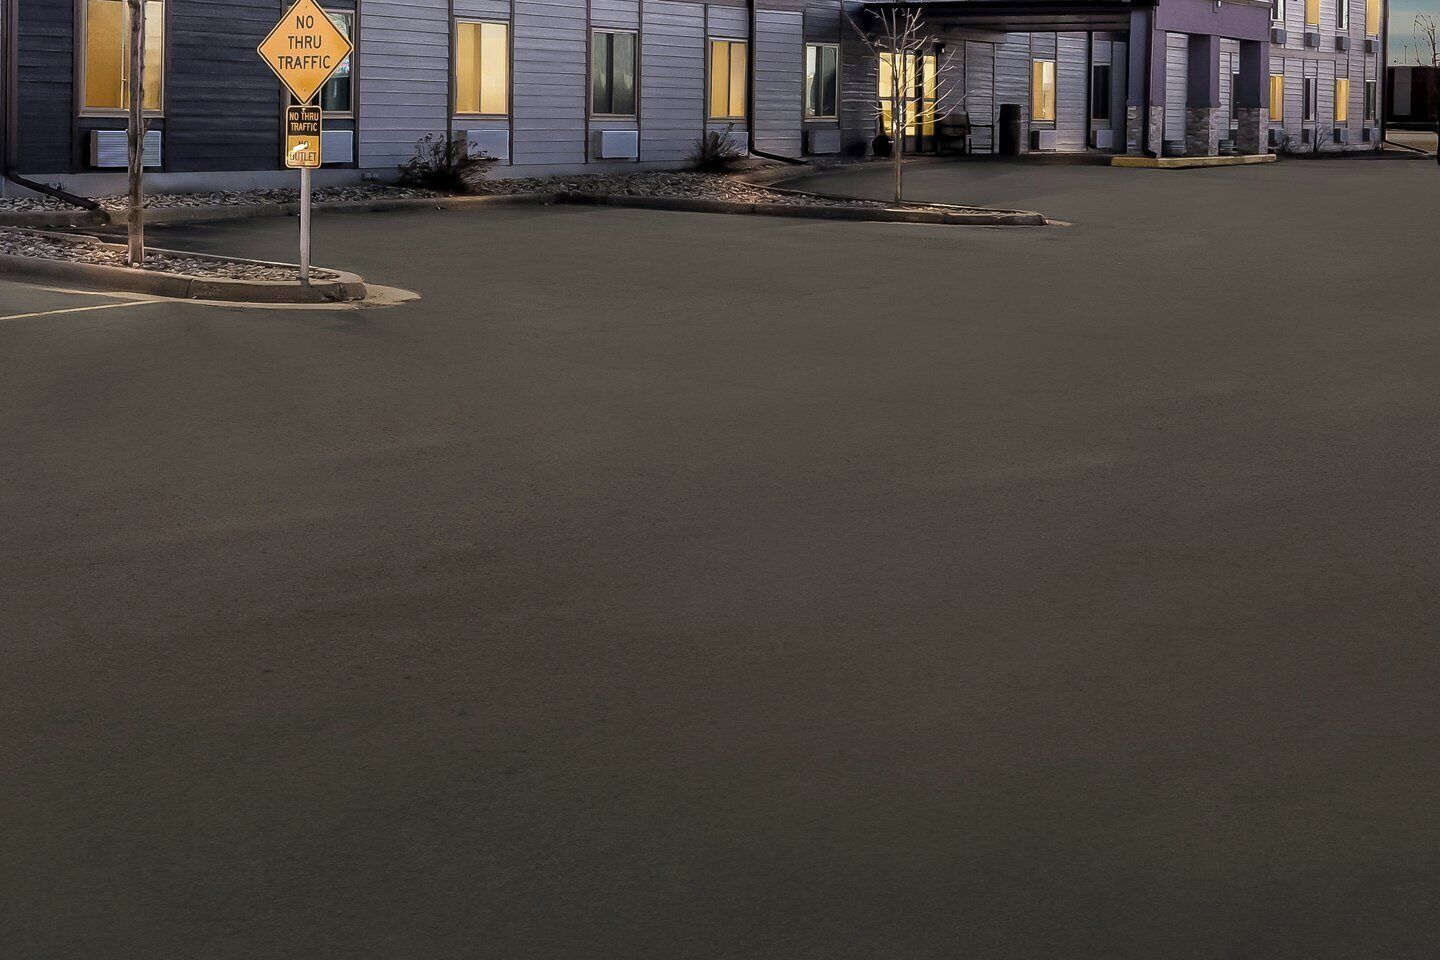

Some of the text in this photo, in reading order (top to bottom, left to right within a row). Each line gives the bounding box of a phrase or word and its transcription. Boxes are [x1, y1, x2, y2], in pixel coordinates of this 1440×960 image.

[296, 15, 314, 29] NO
[288, 35, 322, 50] THRU
[278, 55, 331, 70] TRAFFIC
[289, 112, 319, 121] NO THRU
[291, 122, 318, 132] TRAFFIC
[289, 151, 317, 162] OUTLET
